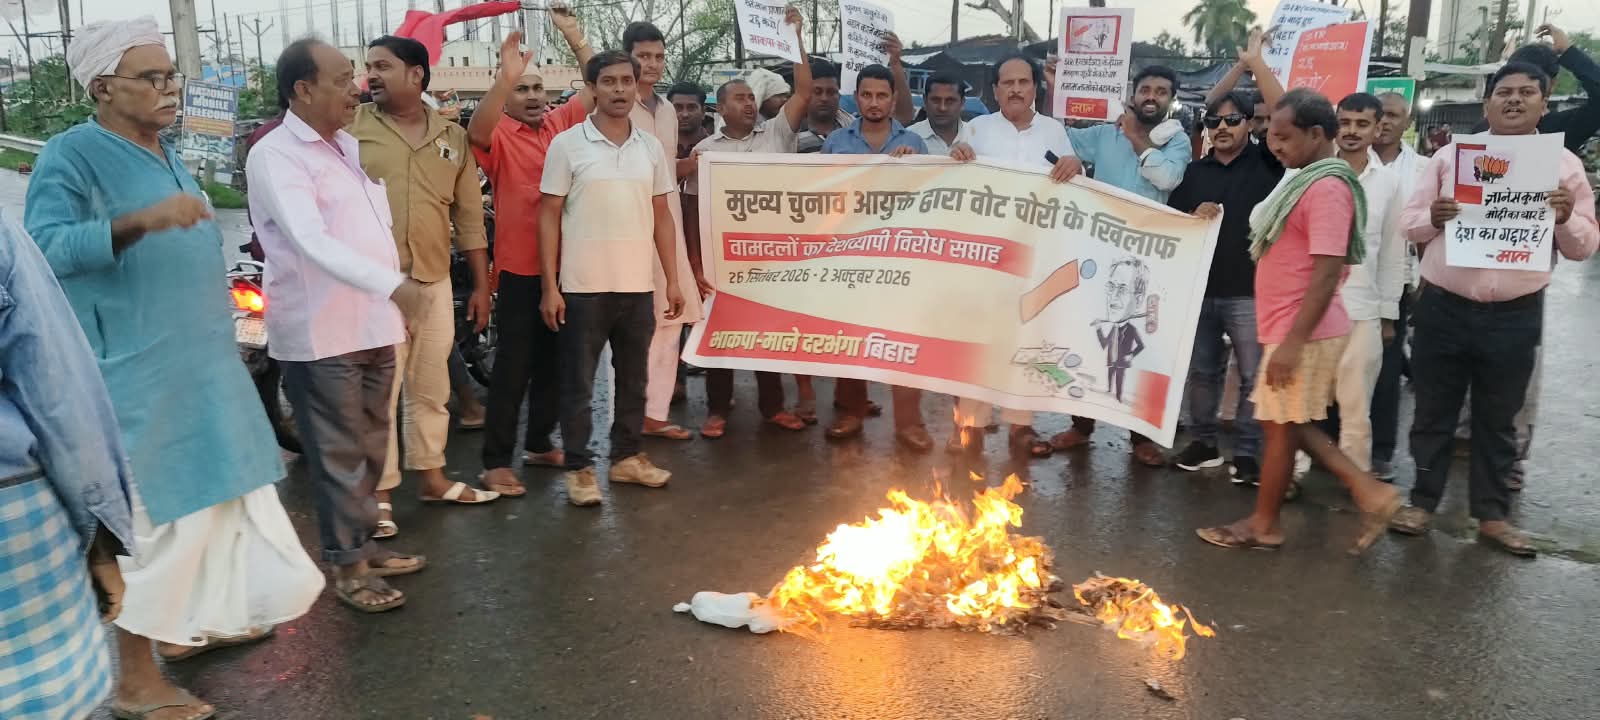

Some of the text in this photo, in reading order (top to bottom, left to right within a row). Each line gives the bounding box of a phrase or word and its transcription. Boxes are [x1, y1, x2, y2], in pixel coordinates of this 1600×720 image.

[189, 86, 234, 101] NATIONAL
[192, 96, 229, 112] MOBILE
[725, 184, 1182, 260] मुख्य चुनाव आयुक्त द्वारा वोट चोरी के खिलाफ
[1485, 206, 1507, 221] मोदी
[1507, 210, 1518, 221] का
[1521, 210, 1539, 221] यार
[1455, 220, 1476, 243] देश
[1478, 227, 1498, 241] का
[1499, 227, 1529, 247] गद्दार
[728, 228, 1004, 264] वामदलों का देशव्यापी विरोध सप्ताह
[1496, 244, 1535, 263] माले
[747, 268, 781, 284] सितंबर
[780, 268, 811, 284] 2026
[820, 268, 828, 283] 2
[830, 269, 875, 288] अक्टूबर
[875, 269, 911, 287] 2026
[710, 327, 920, 365] भाकपा-माले दरभंगा बिहार
